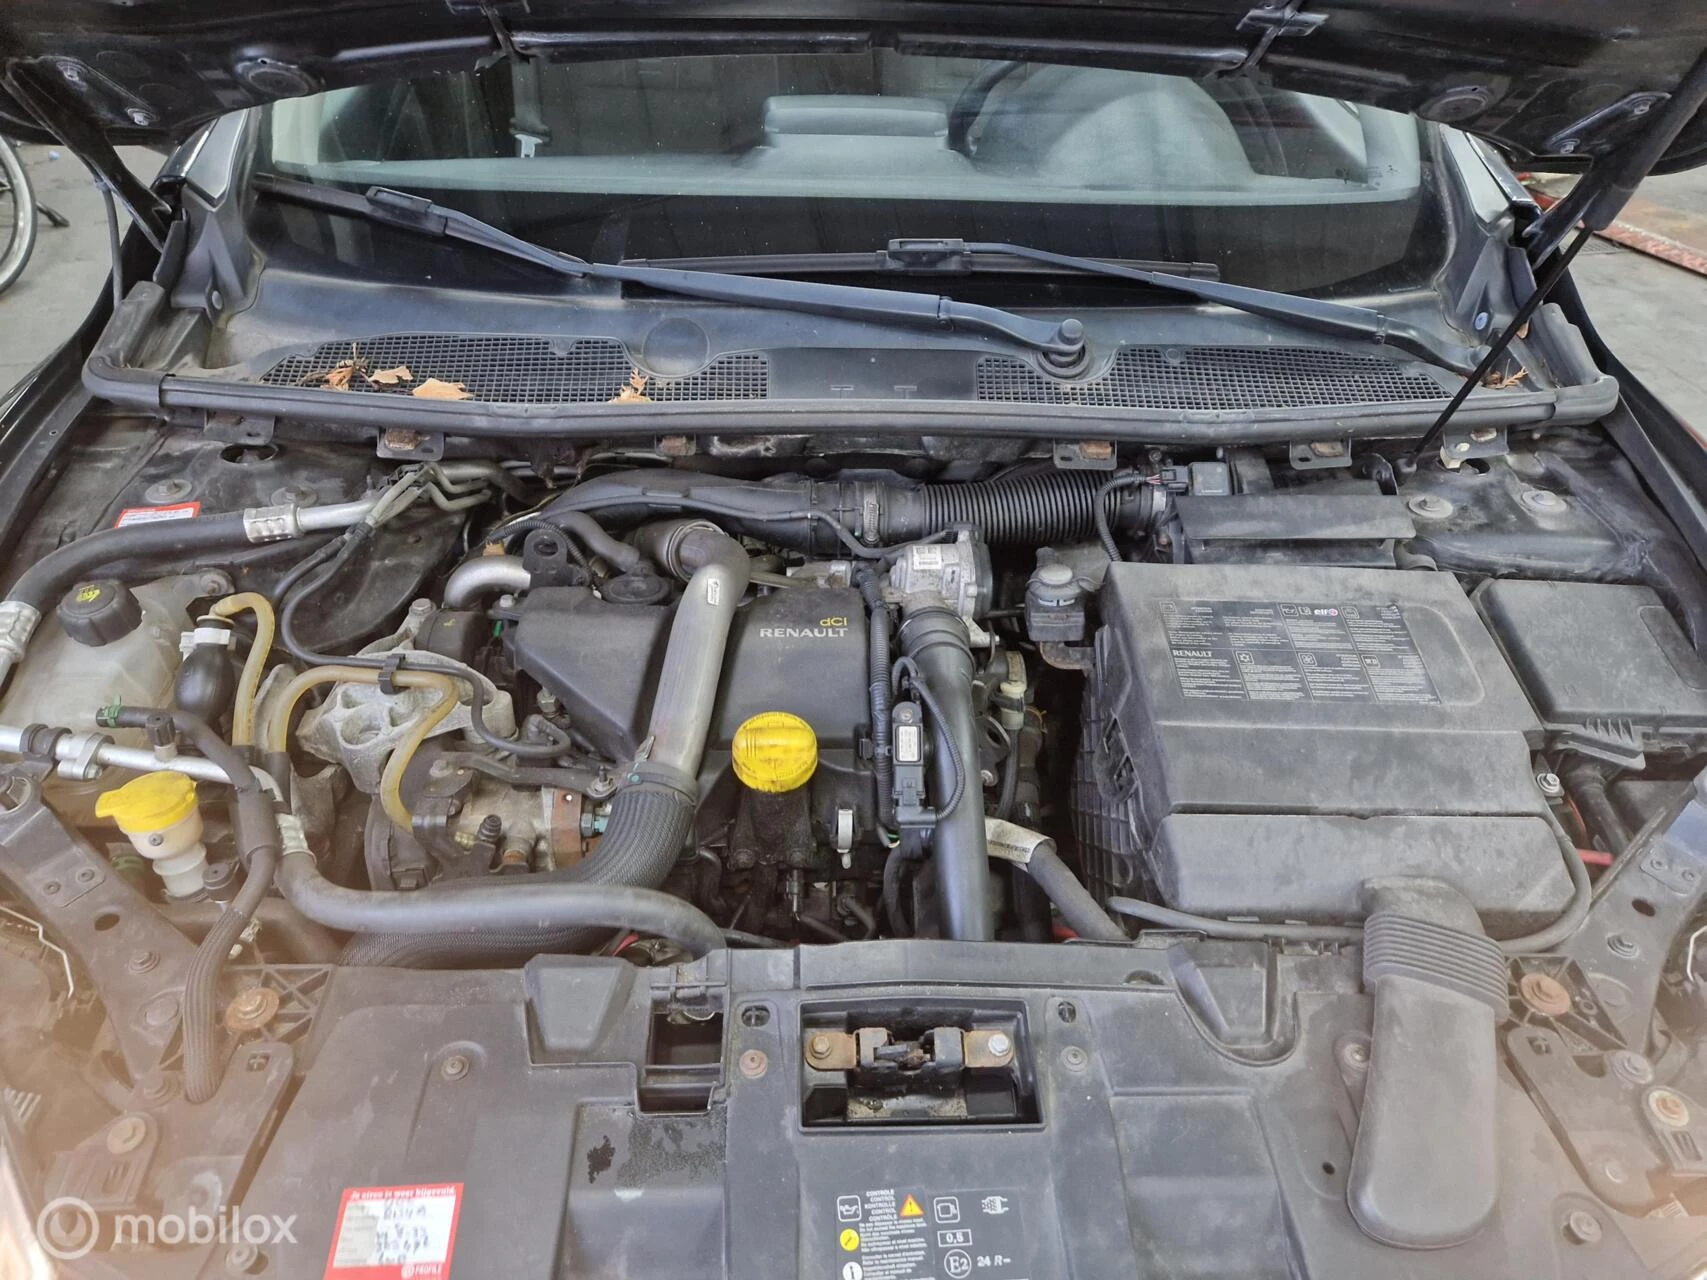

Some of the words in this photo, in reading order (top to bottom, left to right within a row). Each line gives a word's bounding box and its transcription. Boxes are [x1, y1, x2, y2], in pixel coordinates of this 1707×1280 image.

[1313, 608, 1328, 616] elf
[760, 628, 848, 638] RENAULT
[1172, 649, 1213, 658] RENAULT
[948, 1255, 969, 1273] E2
[976, 1255, 991, 1267] 24
